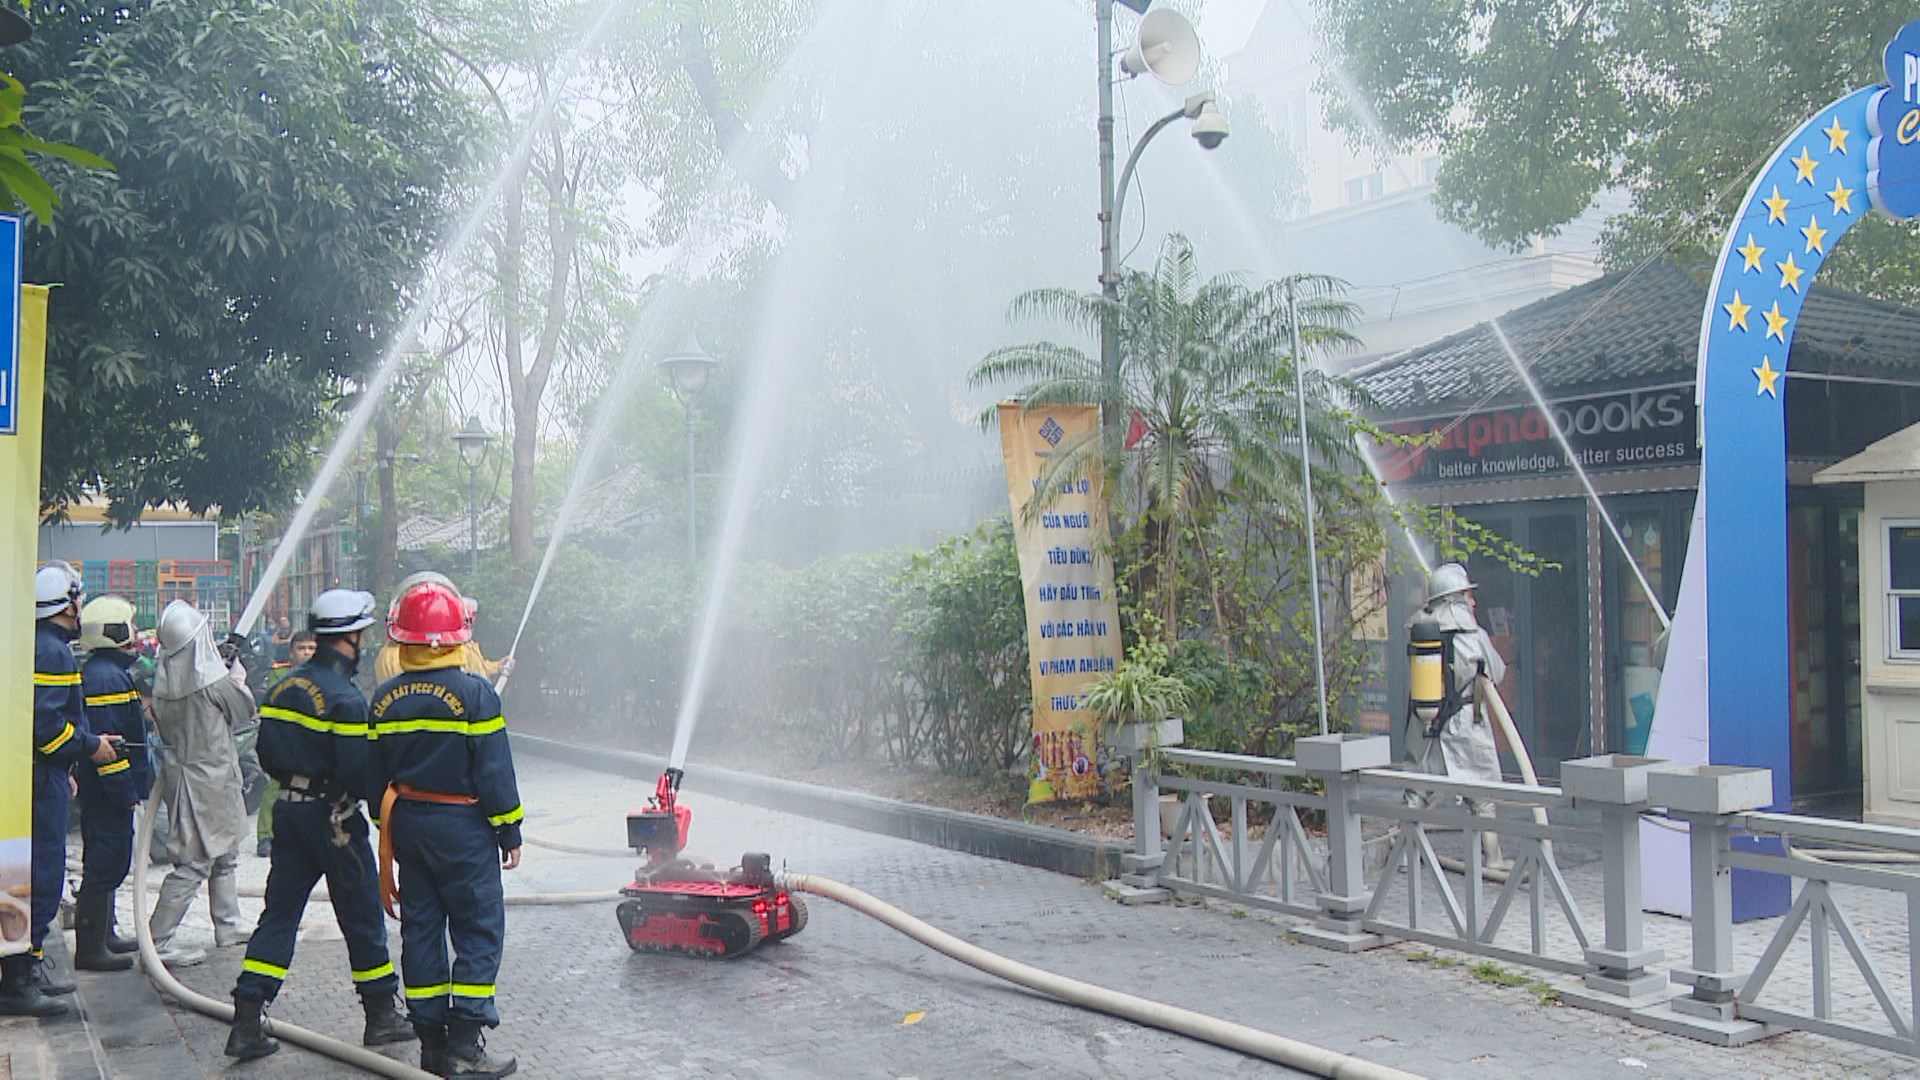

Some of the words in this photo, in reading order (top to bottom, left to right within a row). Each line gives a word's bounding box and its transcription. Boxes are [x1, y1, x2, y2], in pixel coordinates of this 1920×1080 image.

[1904, 53, 1920, 104] P
[1438, 461, 1478, 478] better
[1616, 442, 1685, 463] success
